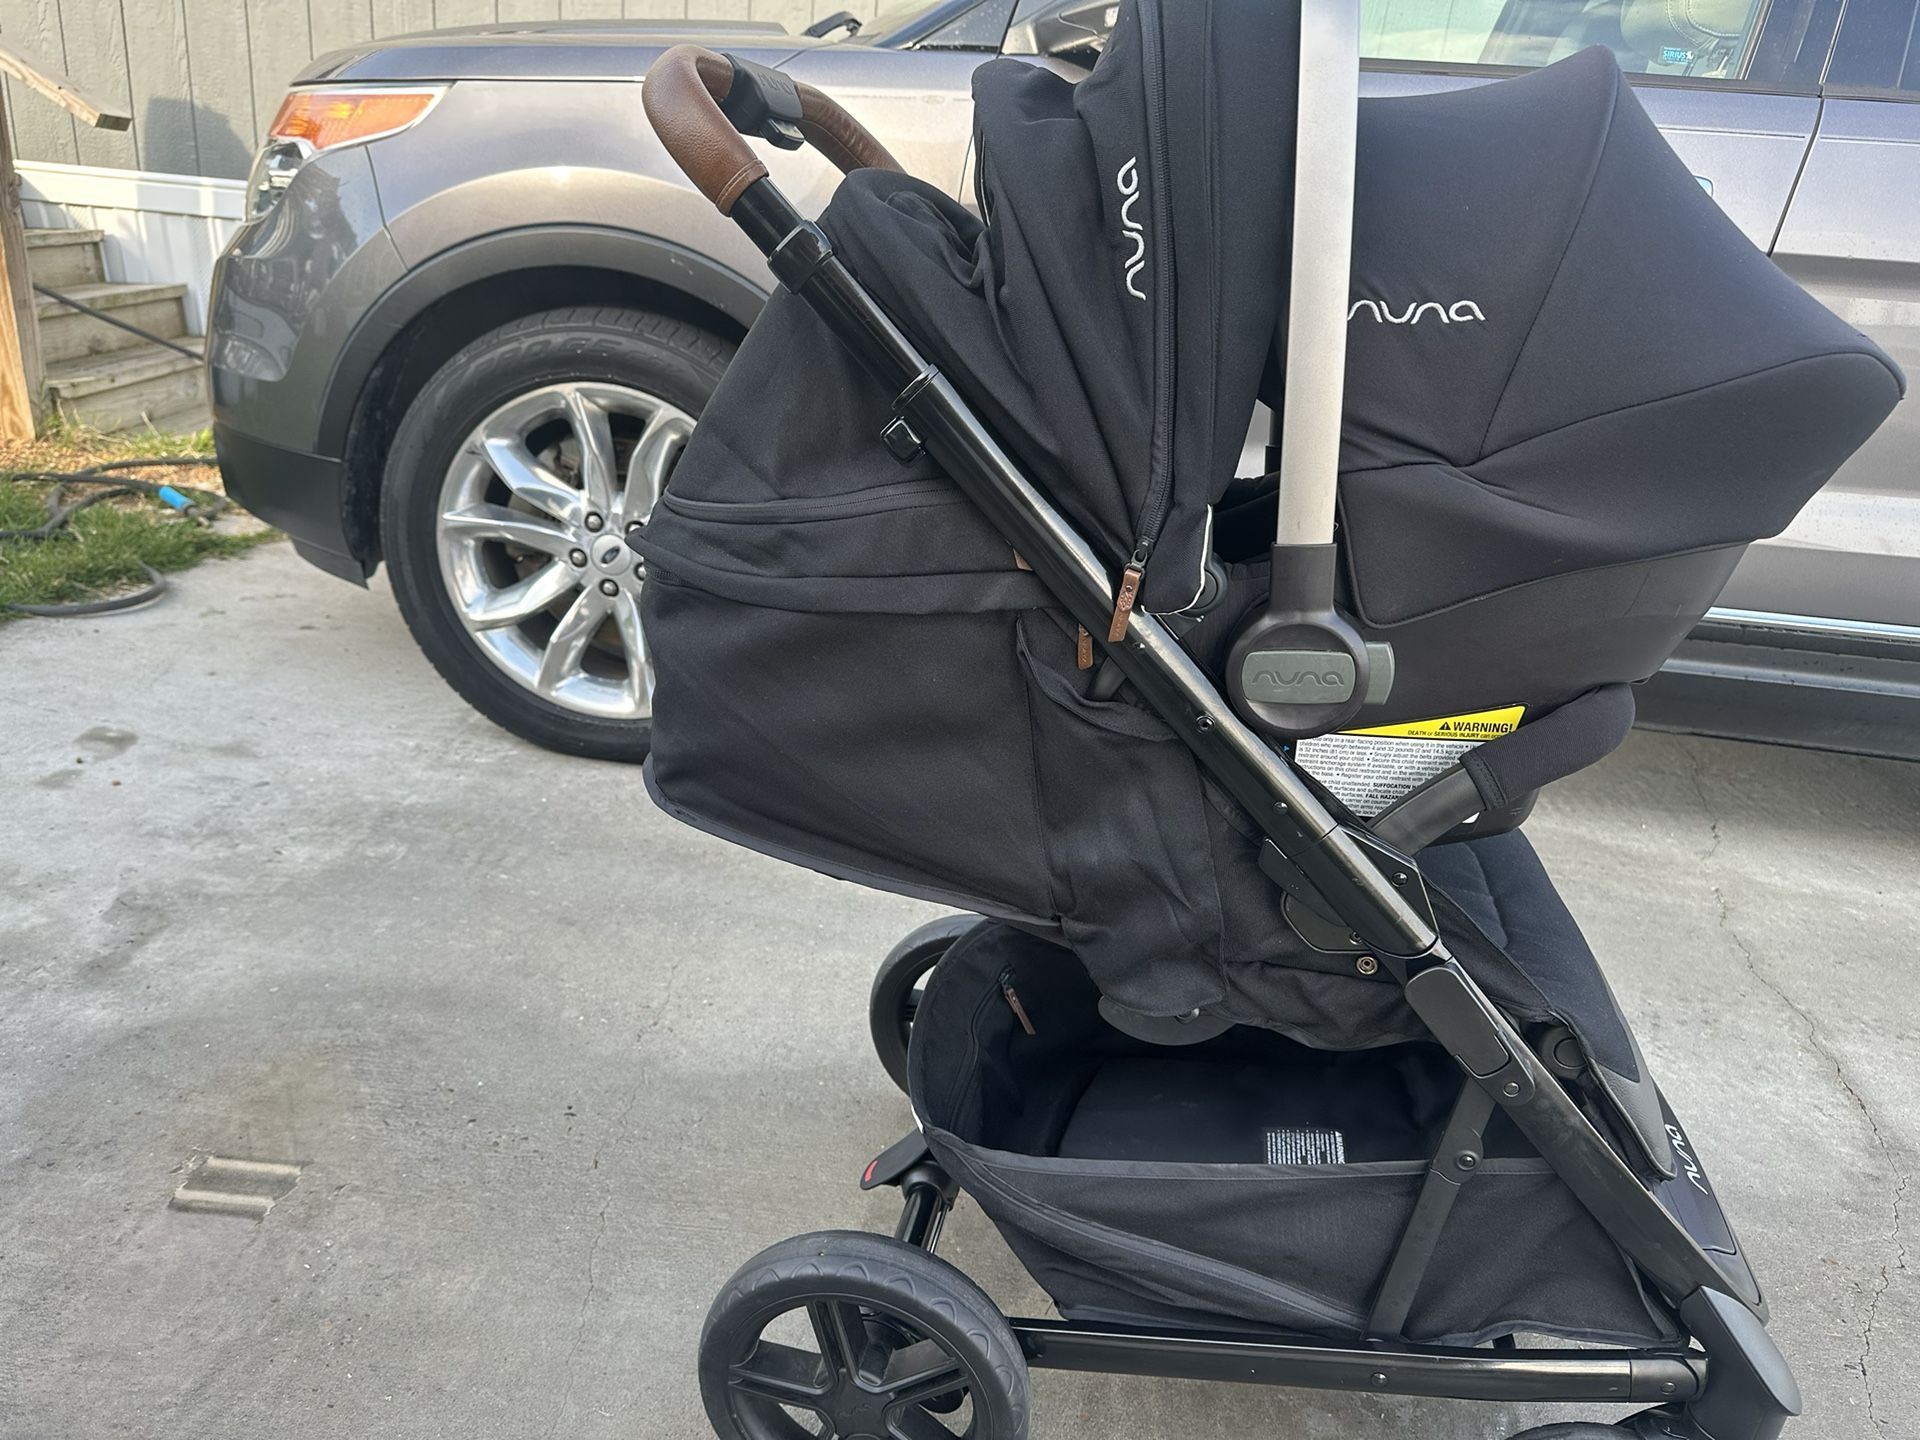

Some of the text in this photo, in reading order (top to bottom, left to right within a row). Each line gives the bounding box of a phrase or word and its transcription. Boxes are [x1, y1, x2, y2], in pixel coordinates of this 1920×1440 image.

[1664, 50, 1686, 58] SIRIUS
[1117, 156, 1147, 301] nuna
[1347, 299, 1486, 325] nuna
[1252, 670, 1345, 687] nuna
[1453, 721, 1513, 733] WARNING!
[1665, 1124, 1709, 1195] nuna
